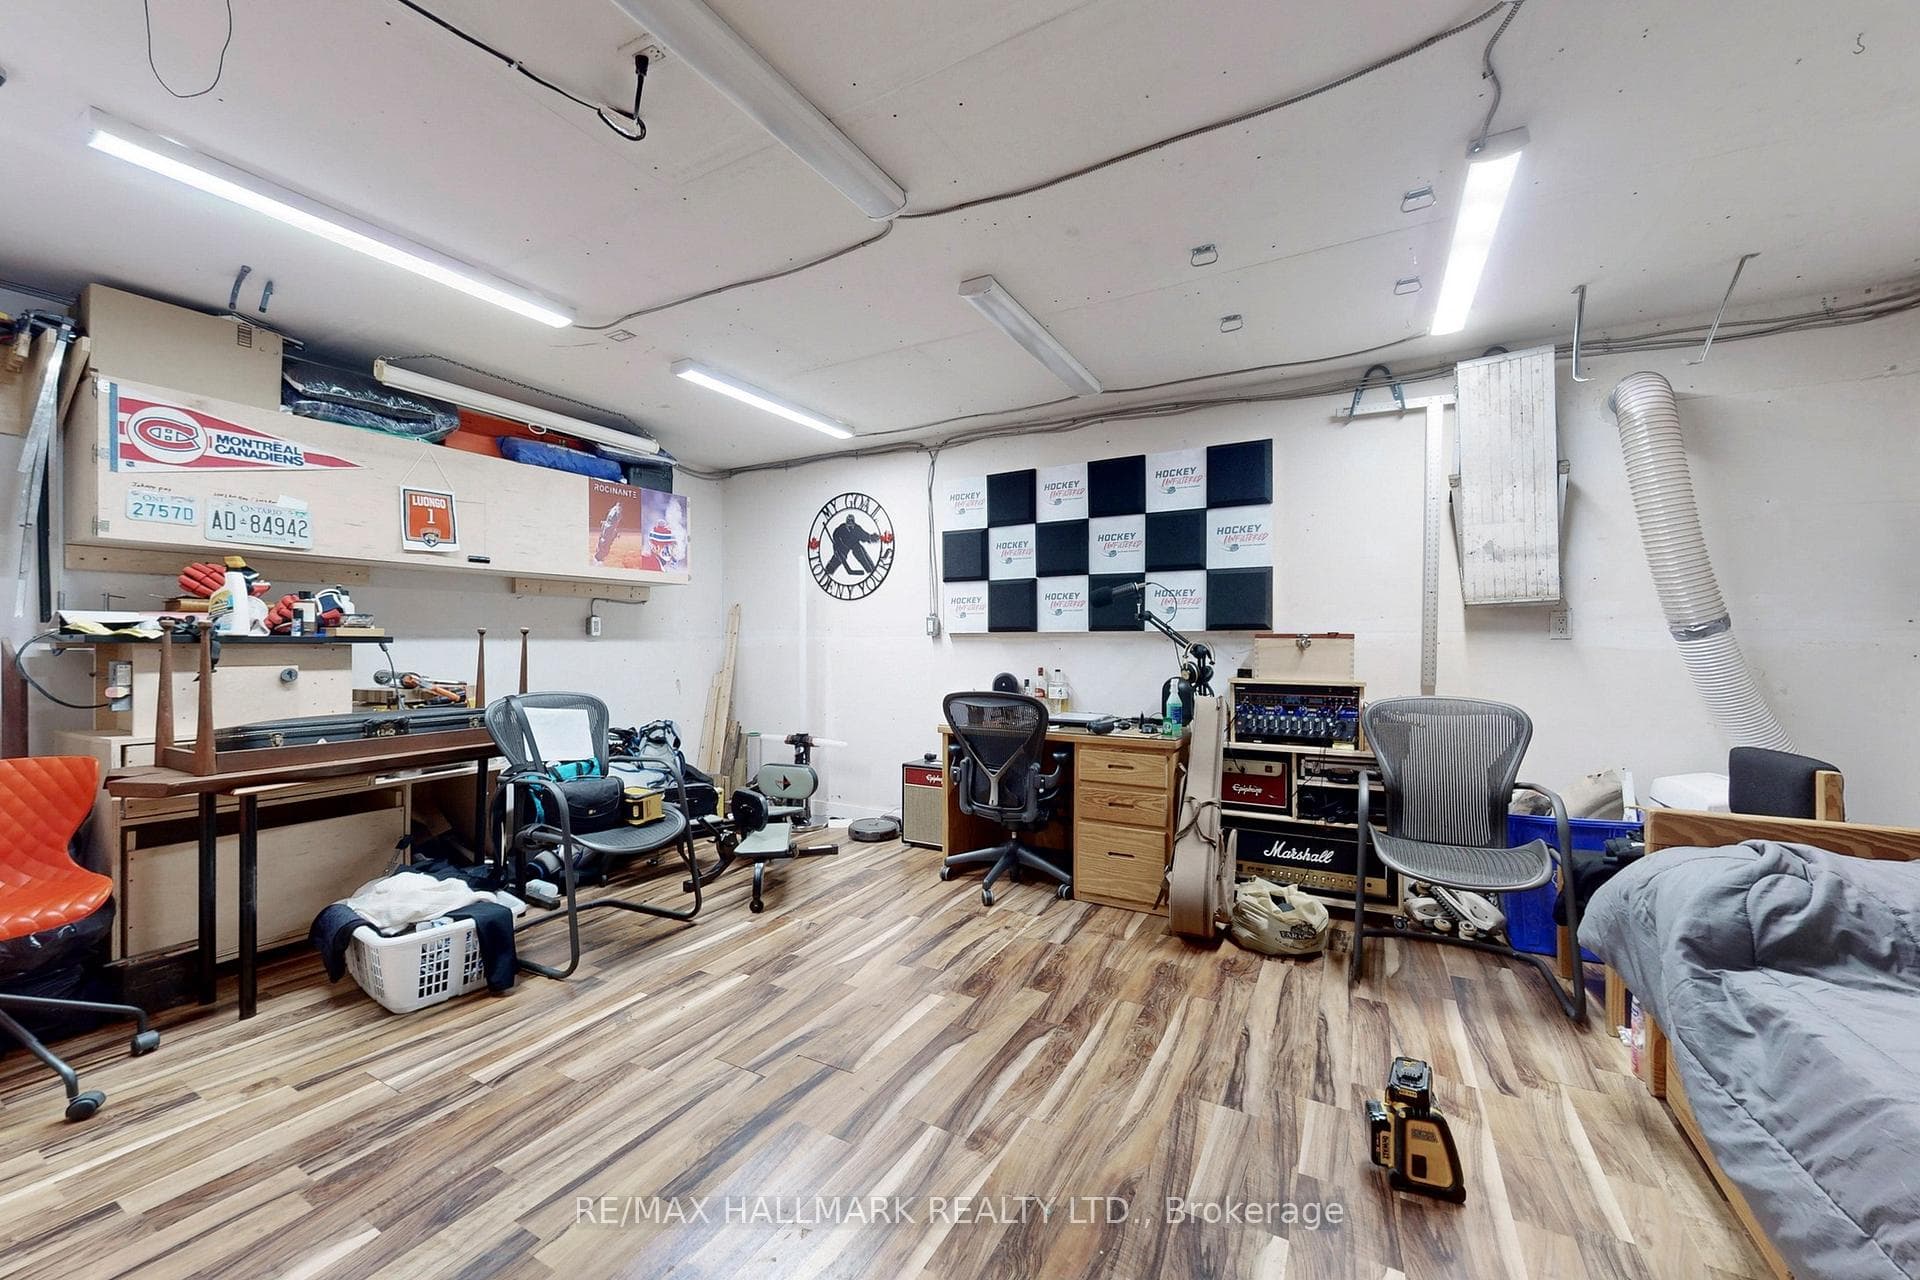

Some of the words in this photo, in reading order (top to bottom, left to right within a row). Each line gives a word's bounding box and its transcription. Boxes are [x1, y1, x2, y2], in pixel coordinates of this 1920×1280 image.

[216, 434, 302, 456] MONTREAL
[215, 444, 304, 467] CANADIENS
[1155, 466, 1197, 479] HOCKEY
[593, 483, 638, 499] ROCINANTE
[1044, 480, 1080, 491] HOCKEY
[411, 494, 447, 509] LUONGO
[949, 491, 981, 501] HOCKEY
[821, 499, 838, 518] MY
[426, 508, 436, 524] 1
[1216, 523, 1262, 535] HOCKEY
[1097, 532, 1136, 542] HOCKEY
[996, 540, 1029, 550] HOCKEY
[950, 596, 982, 605] HOCKEY
[1044, 592, 1080, 601] HOCKEY
[1263, 840, 1335, 864] Marshall
